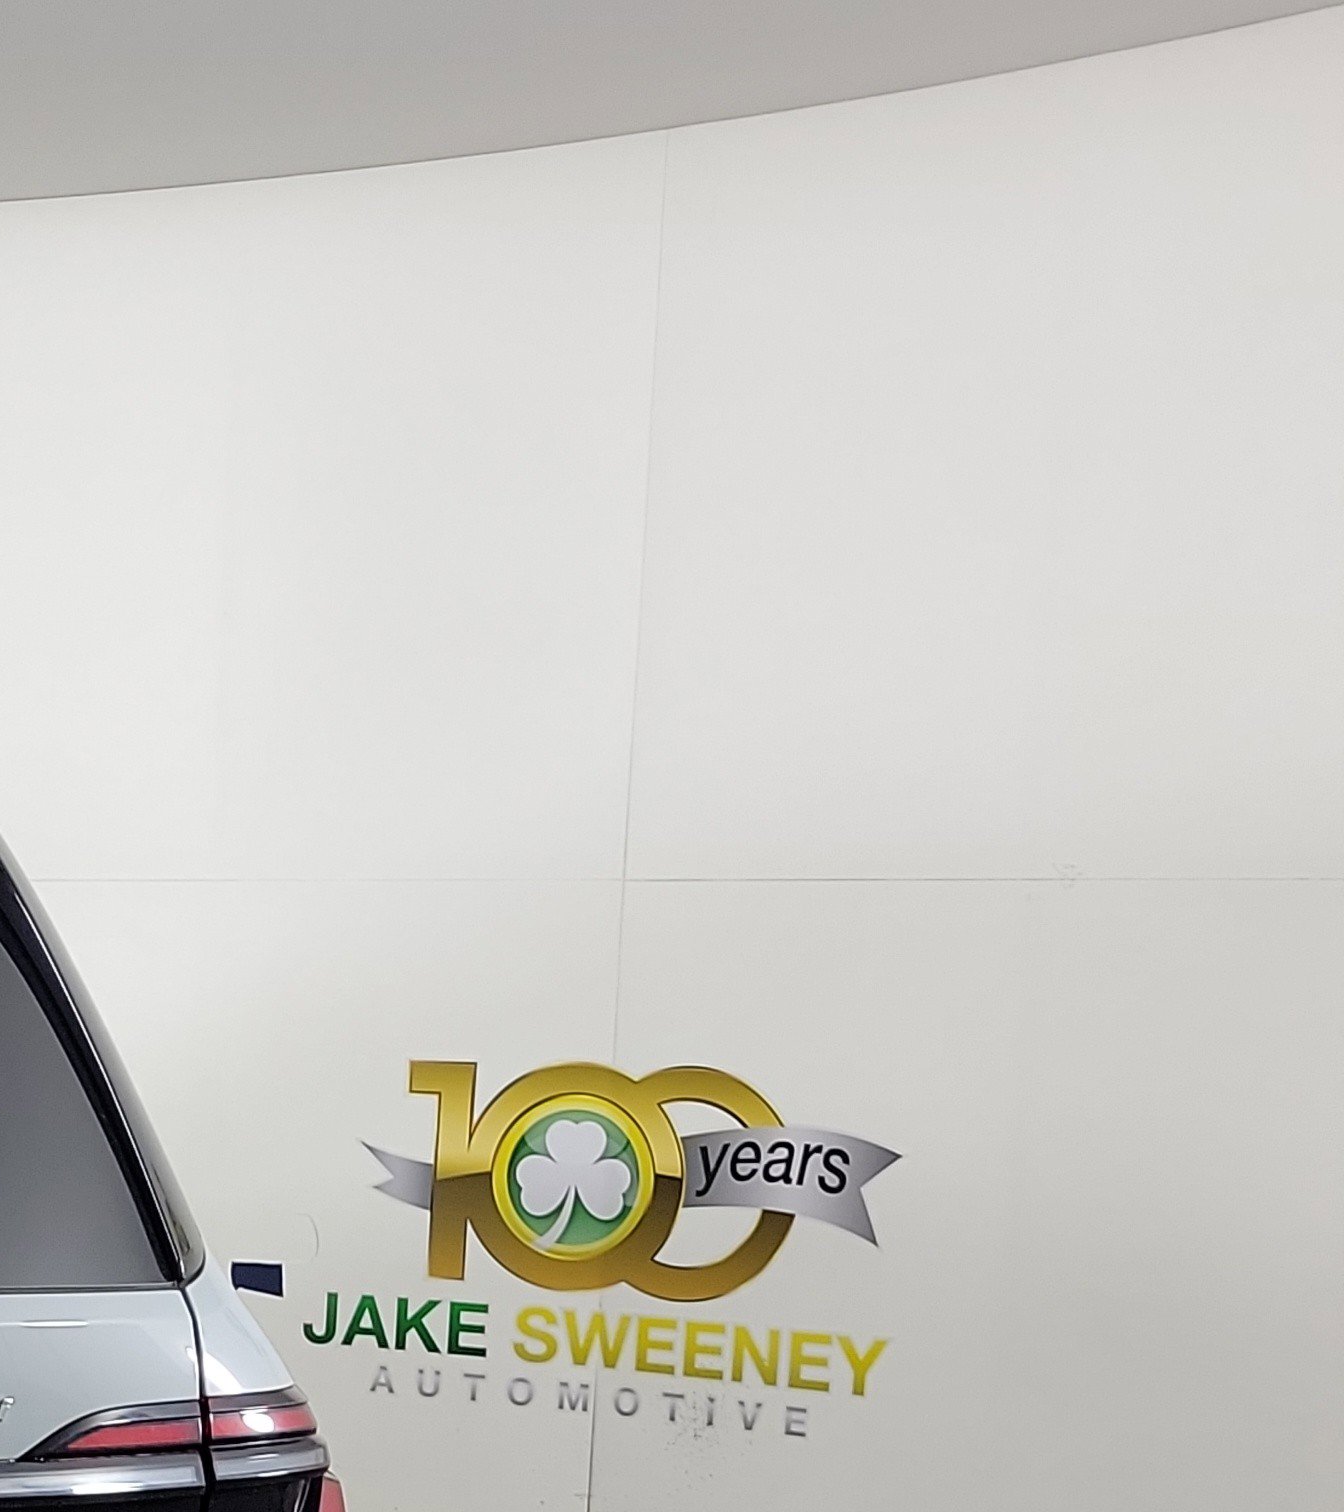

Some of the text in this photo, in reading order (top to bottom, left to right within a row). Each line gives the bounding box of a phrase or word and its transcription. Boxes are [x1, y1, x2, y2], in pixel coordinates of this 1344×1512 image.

[409, 1060, 851, 1302] 100 years
[302, 1292, 887, 1397] JAKE SWEENEY
[369, 1365, 808, 1438] AUTOMOTIVE
